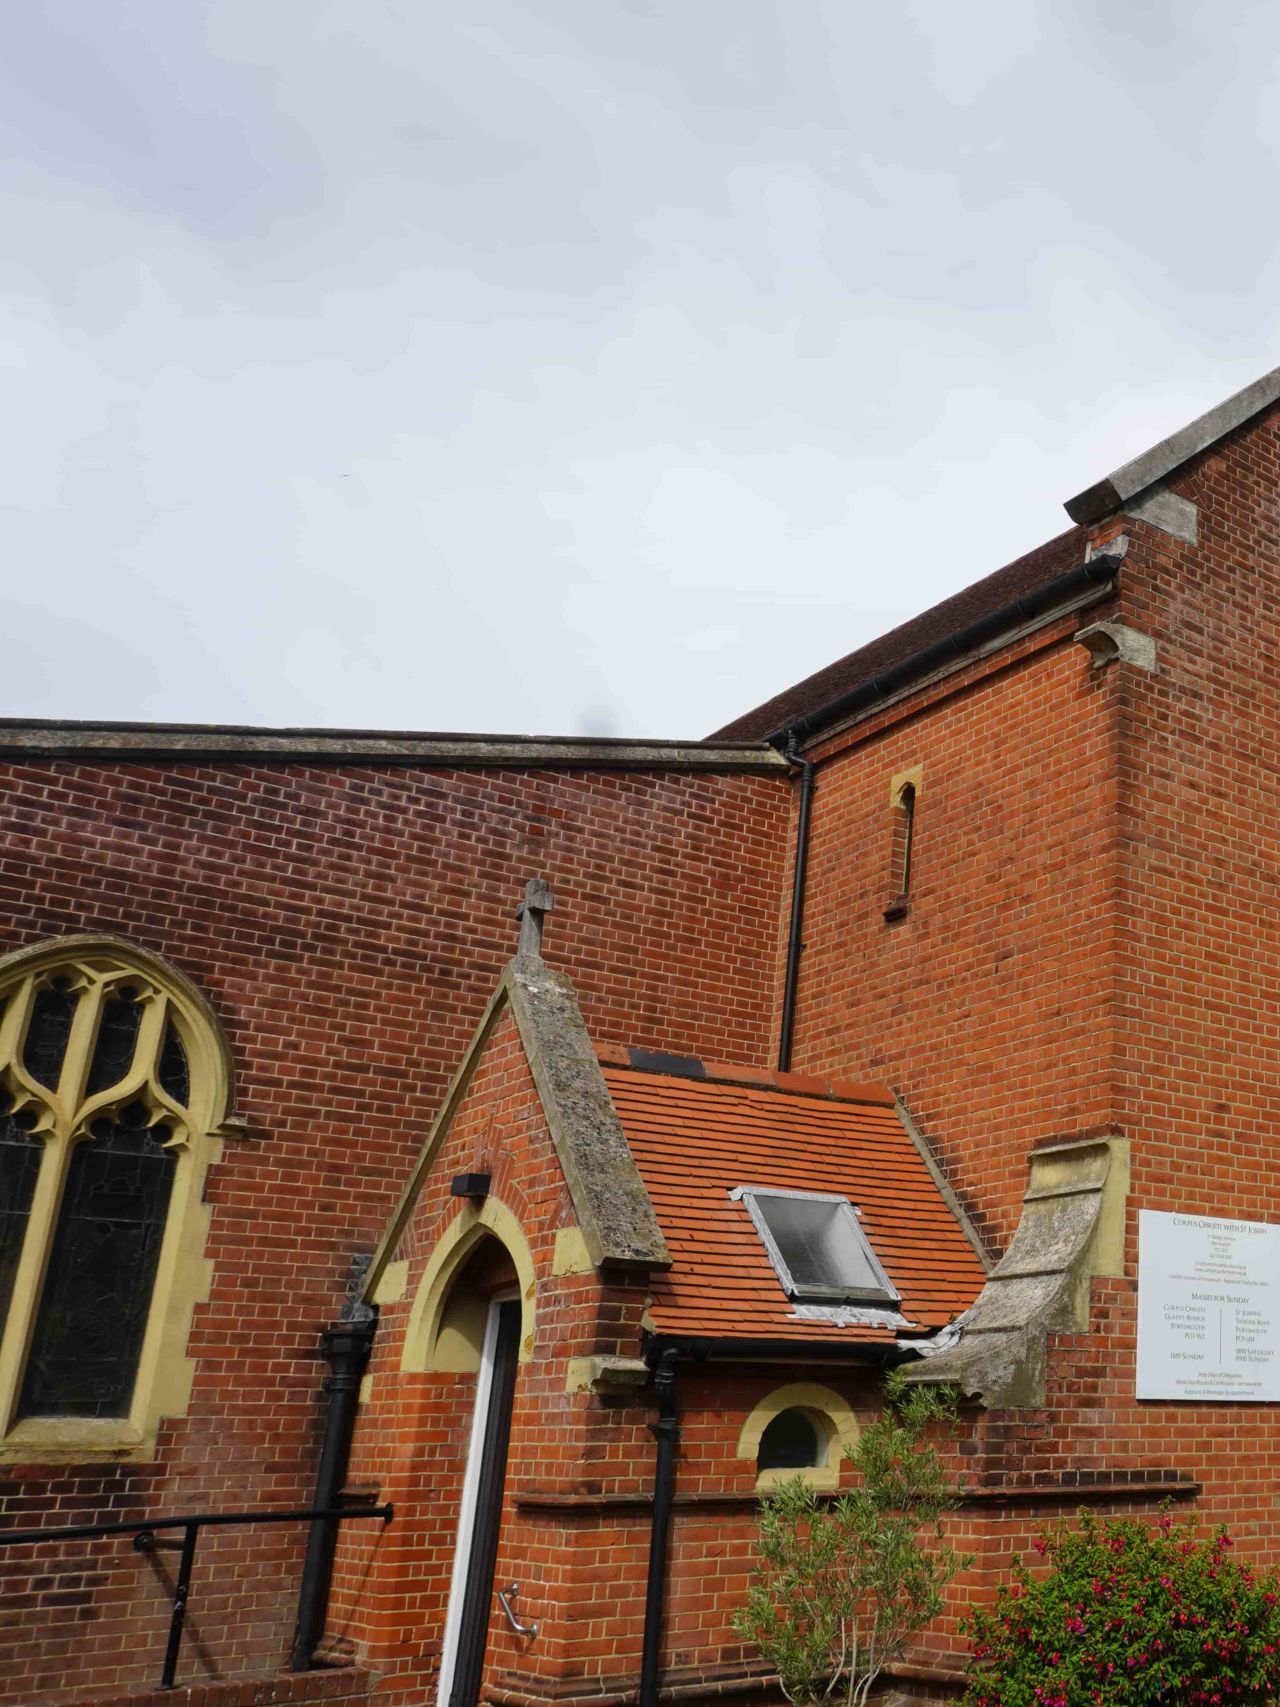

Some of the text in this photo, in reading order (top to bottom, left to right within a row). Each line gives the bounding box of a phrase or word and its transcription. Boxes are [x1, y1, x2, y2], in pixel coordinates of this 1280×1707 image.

[1173, 1217, 1197, 1228] CORPUS
[1198, 1219, 1222, 1230] CHRISTI
[1224, 1223, 1240, 1232] WITH
[1248, 1226, 1267, 1235] JOSEPH
[1192, 1293, 1250, 1304] MASSES FOR SUNDAY
[1182, 1352, 1204, 1360] SUNDAY
[1248, 1348, 1274, 1356] SATURDAY
